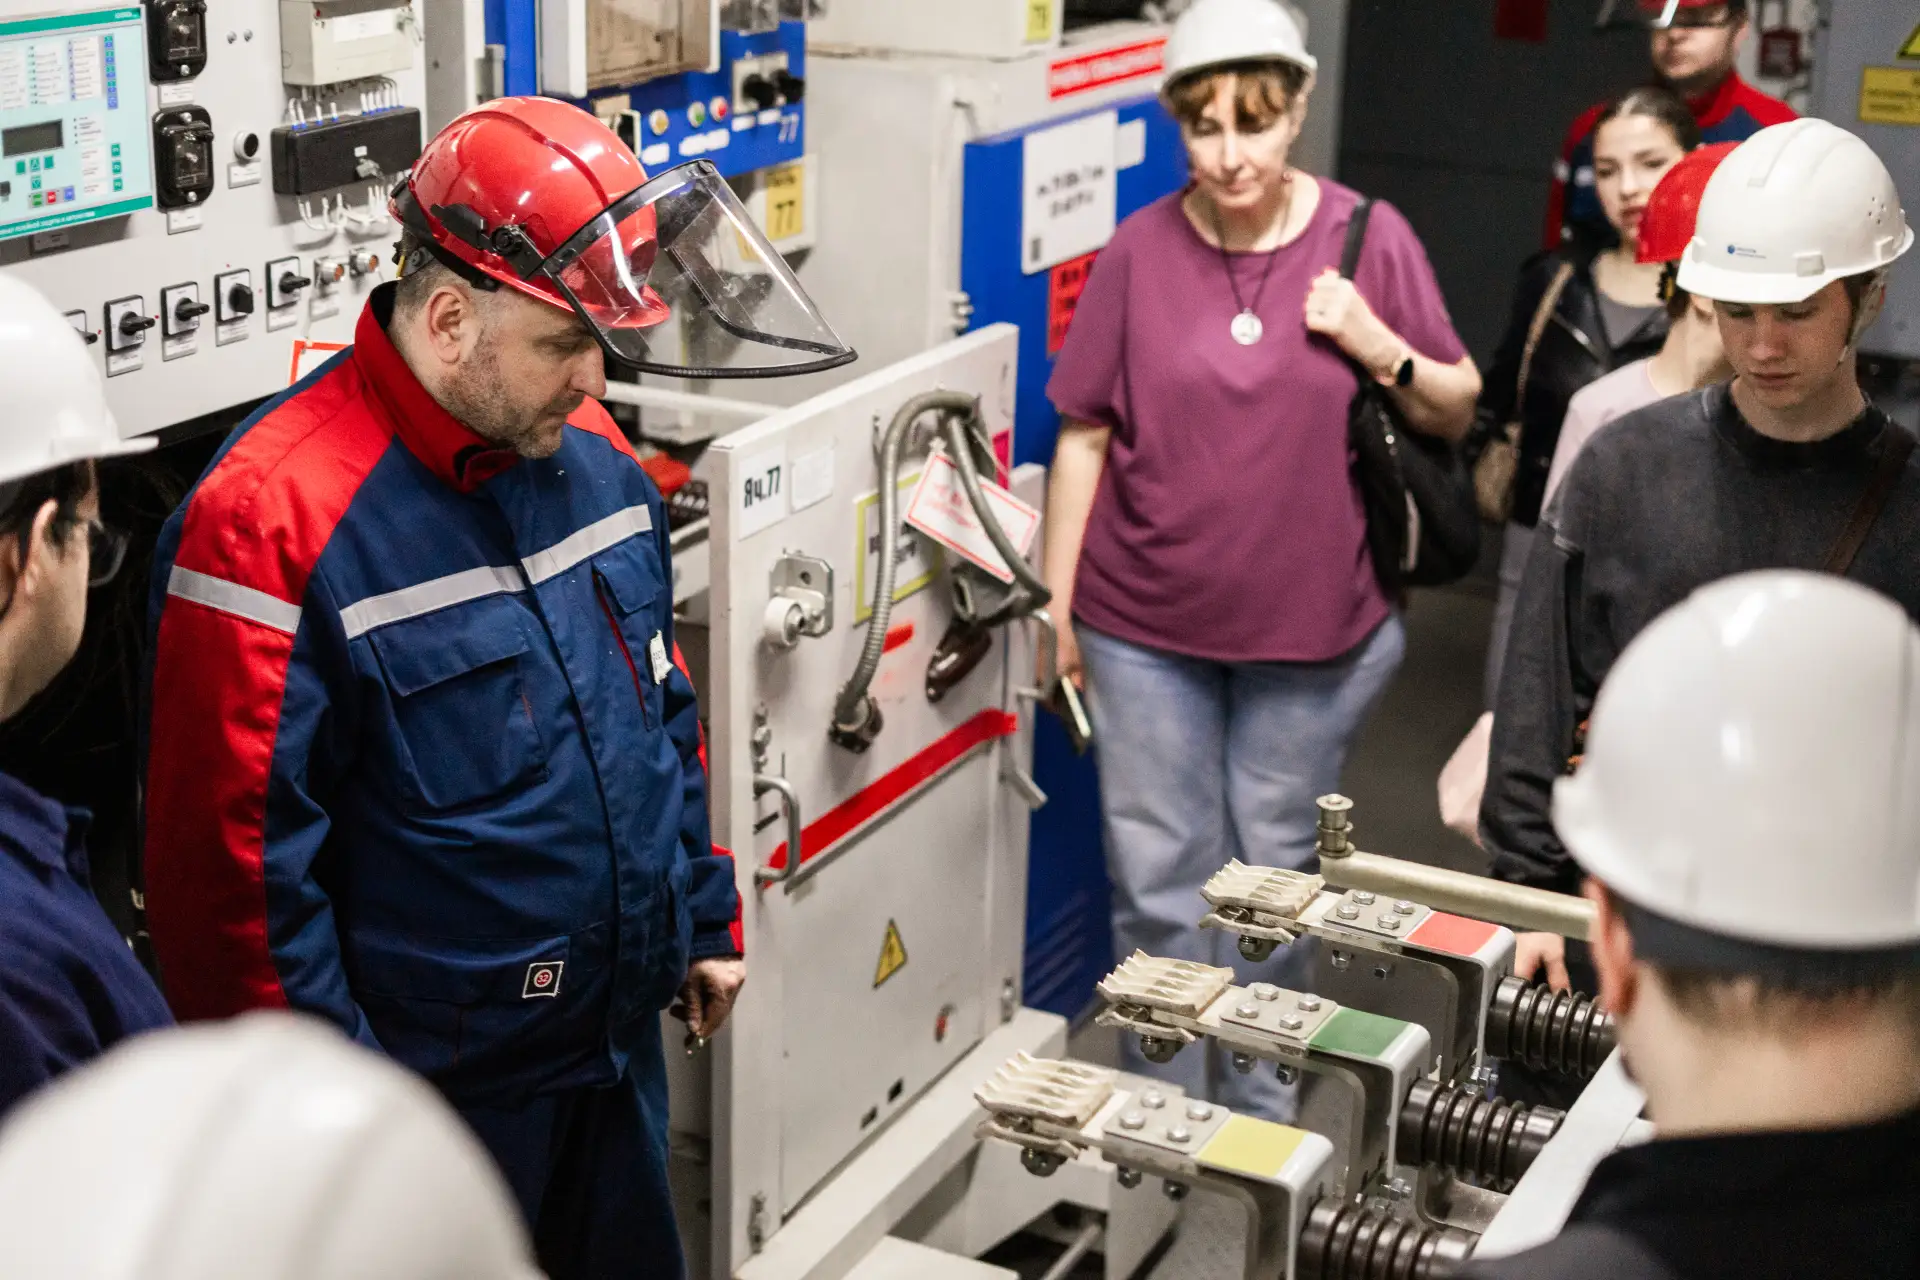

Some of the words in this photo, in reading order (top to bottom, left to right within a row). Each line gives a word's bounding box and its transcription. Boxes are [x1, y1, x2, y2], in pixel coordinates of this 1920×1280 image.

[778, 112, 799, 143] 77
[775, 200, 795, 233] 77
[537, 974, 549, 983] 32
